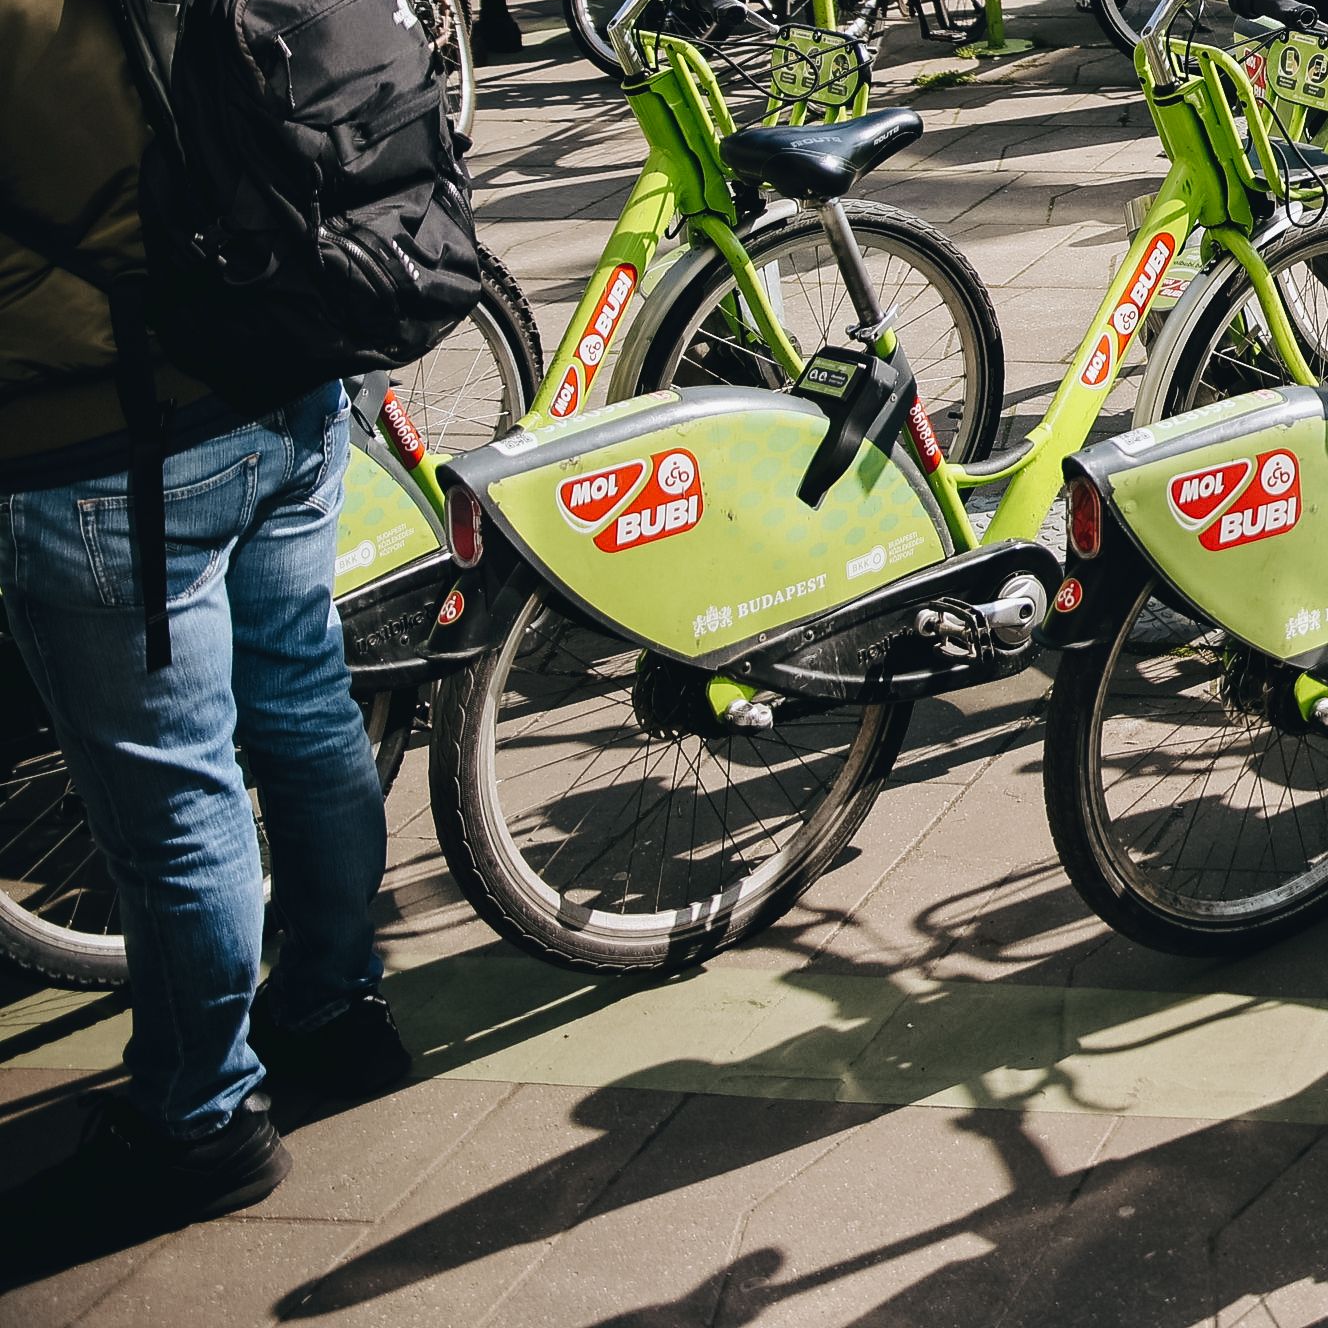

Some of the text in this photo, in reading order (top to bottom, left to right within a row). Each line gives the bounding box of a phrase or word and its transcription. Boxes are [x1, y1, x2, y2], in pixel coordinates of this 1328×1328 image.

[1085, 239, 1170, 384] MOL BUBI
[554, 270, 633, 416] MOL BUBI
[384, 399, 419, 453] 860669
[569, 473, 619, 509] MOL
[1179, 472, 1225, 505] MOL
[616, 494, 699, 546] BUBI
[888, 531, 918, 549] BUDAPESTI
[1219, 495, 1297, 544] BUBI
[852, 558, 870, 572] BKK
[889, 549, 915, 565] KÖZPONT
[737, 573, 827, 618] BUDAPEST
